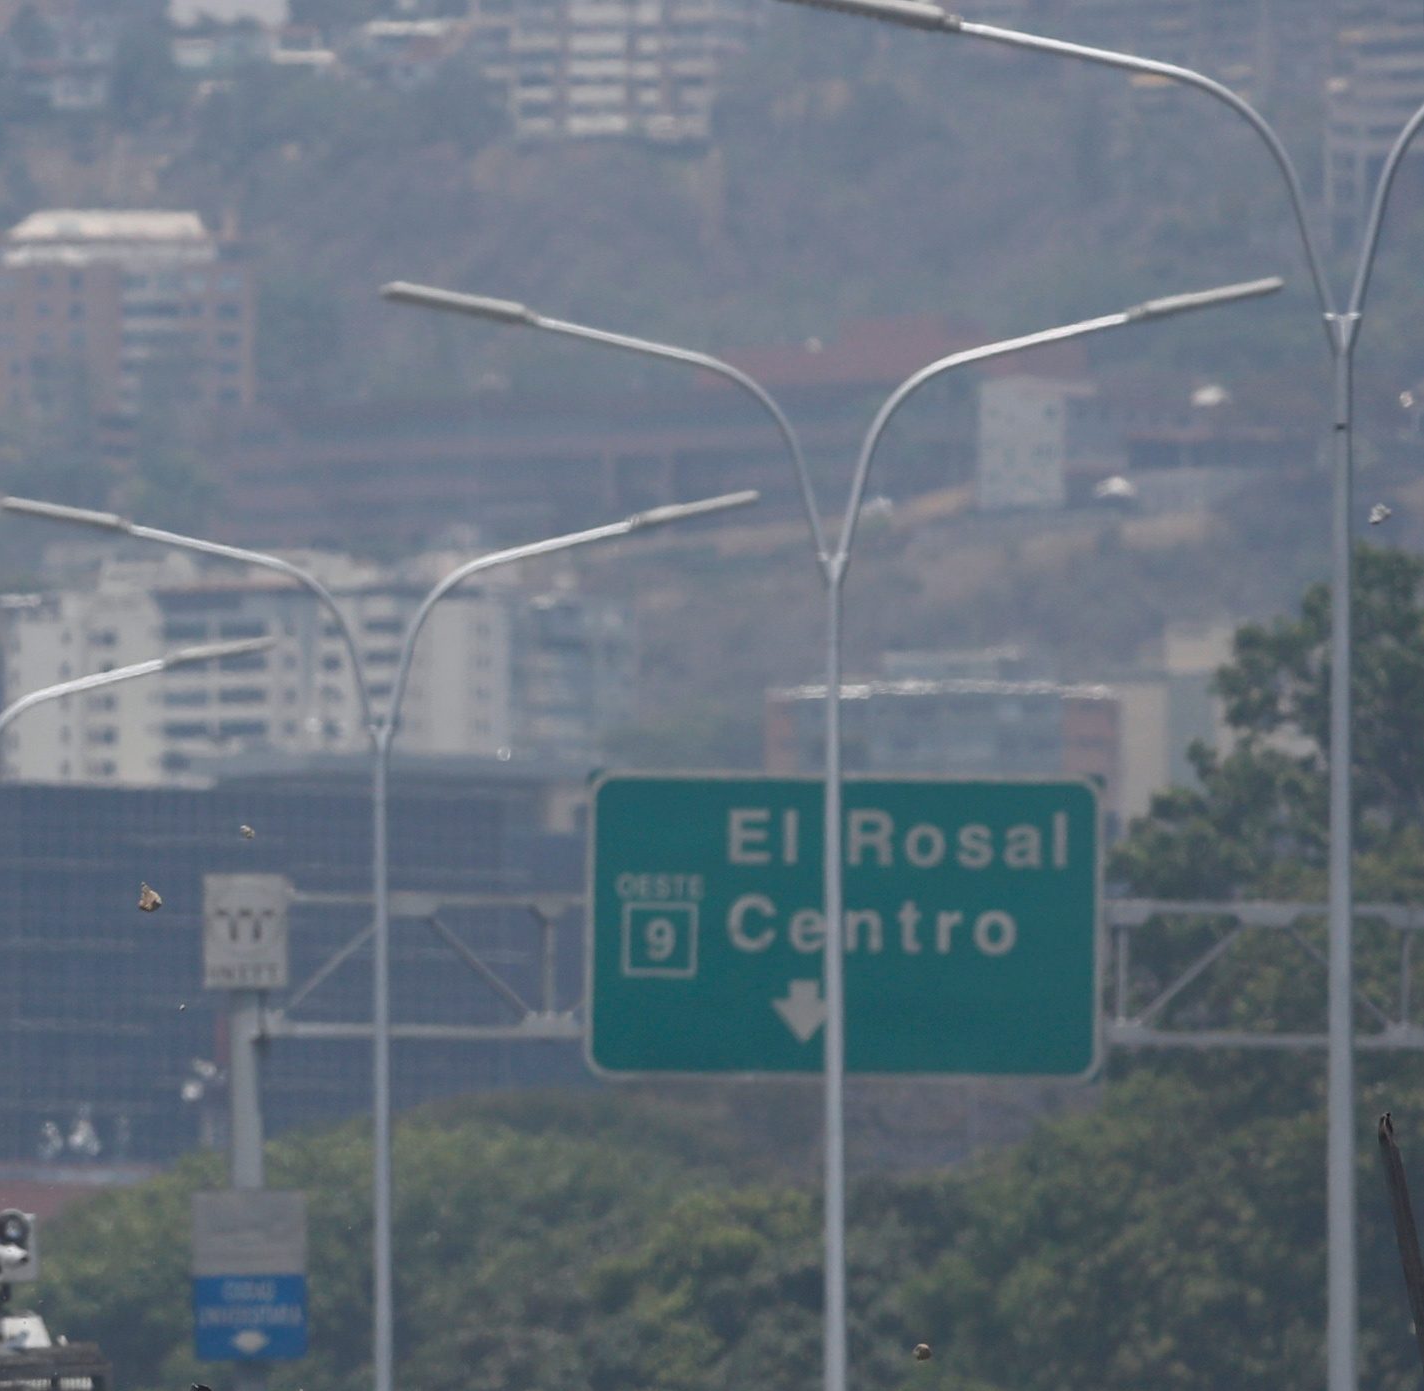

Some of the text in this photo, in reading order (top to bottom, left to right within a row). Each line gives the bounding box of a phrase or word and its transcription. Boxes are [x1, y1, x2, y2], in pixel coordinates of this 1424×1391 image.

[726, 808, 1069, 869] El Rosal
[614, 872, 704, 900] OESTE
[645, 918, 676, 960] 9
[726, 893, 1018, 956] Centro
